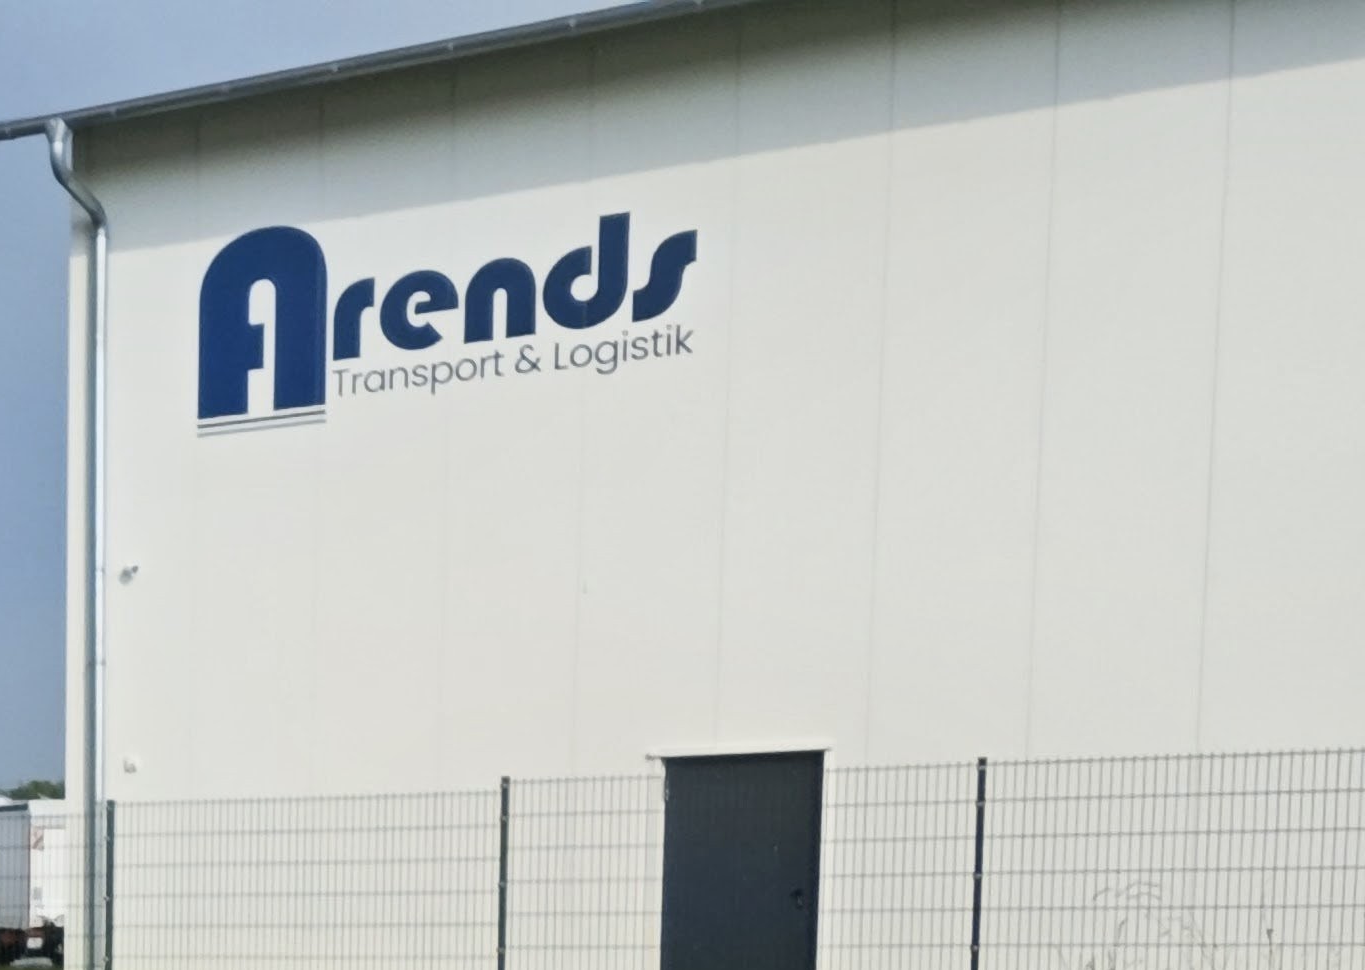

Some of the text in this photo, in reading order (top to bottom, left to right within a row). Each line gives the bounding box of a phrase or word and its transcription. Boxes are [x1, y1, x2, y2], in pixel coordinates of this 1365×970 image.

[198, 211, 697, 419] Arends
[332, 324, 694, 397] Transport & Logistik
